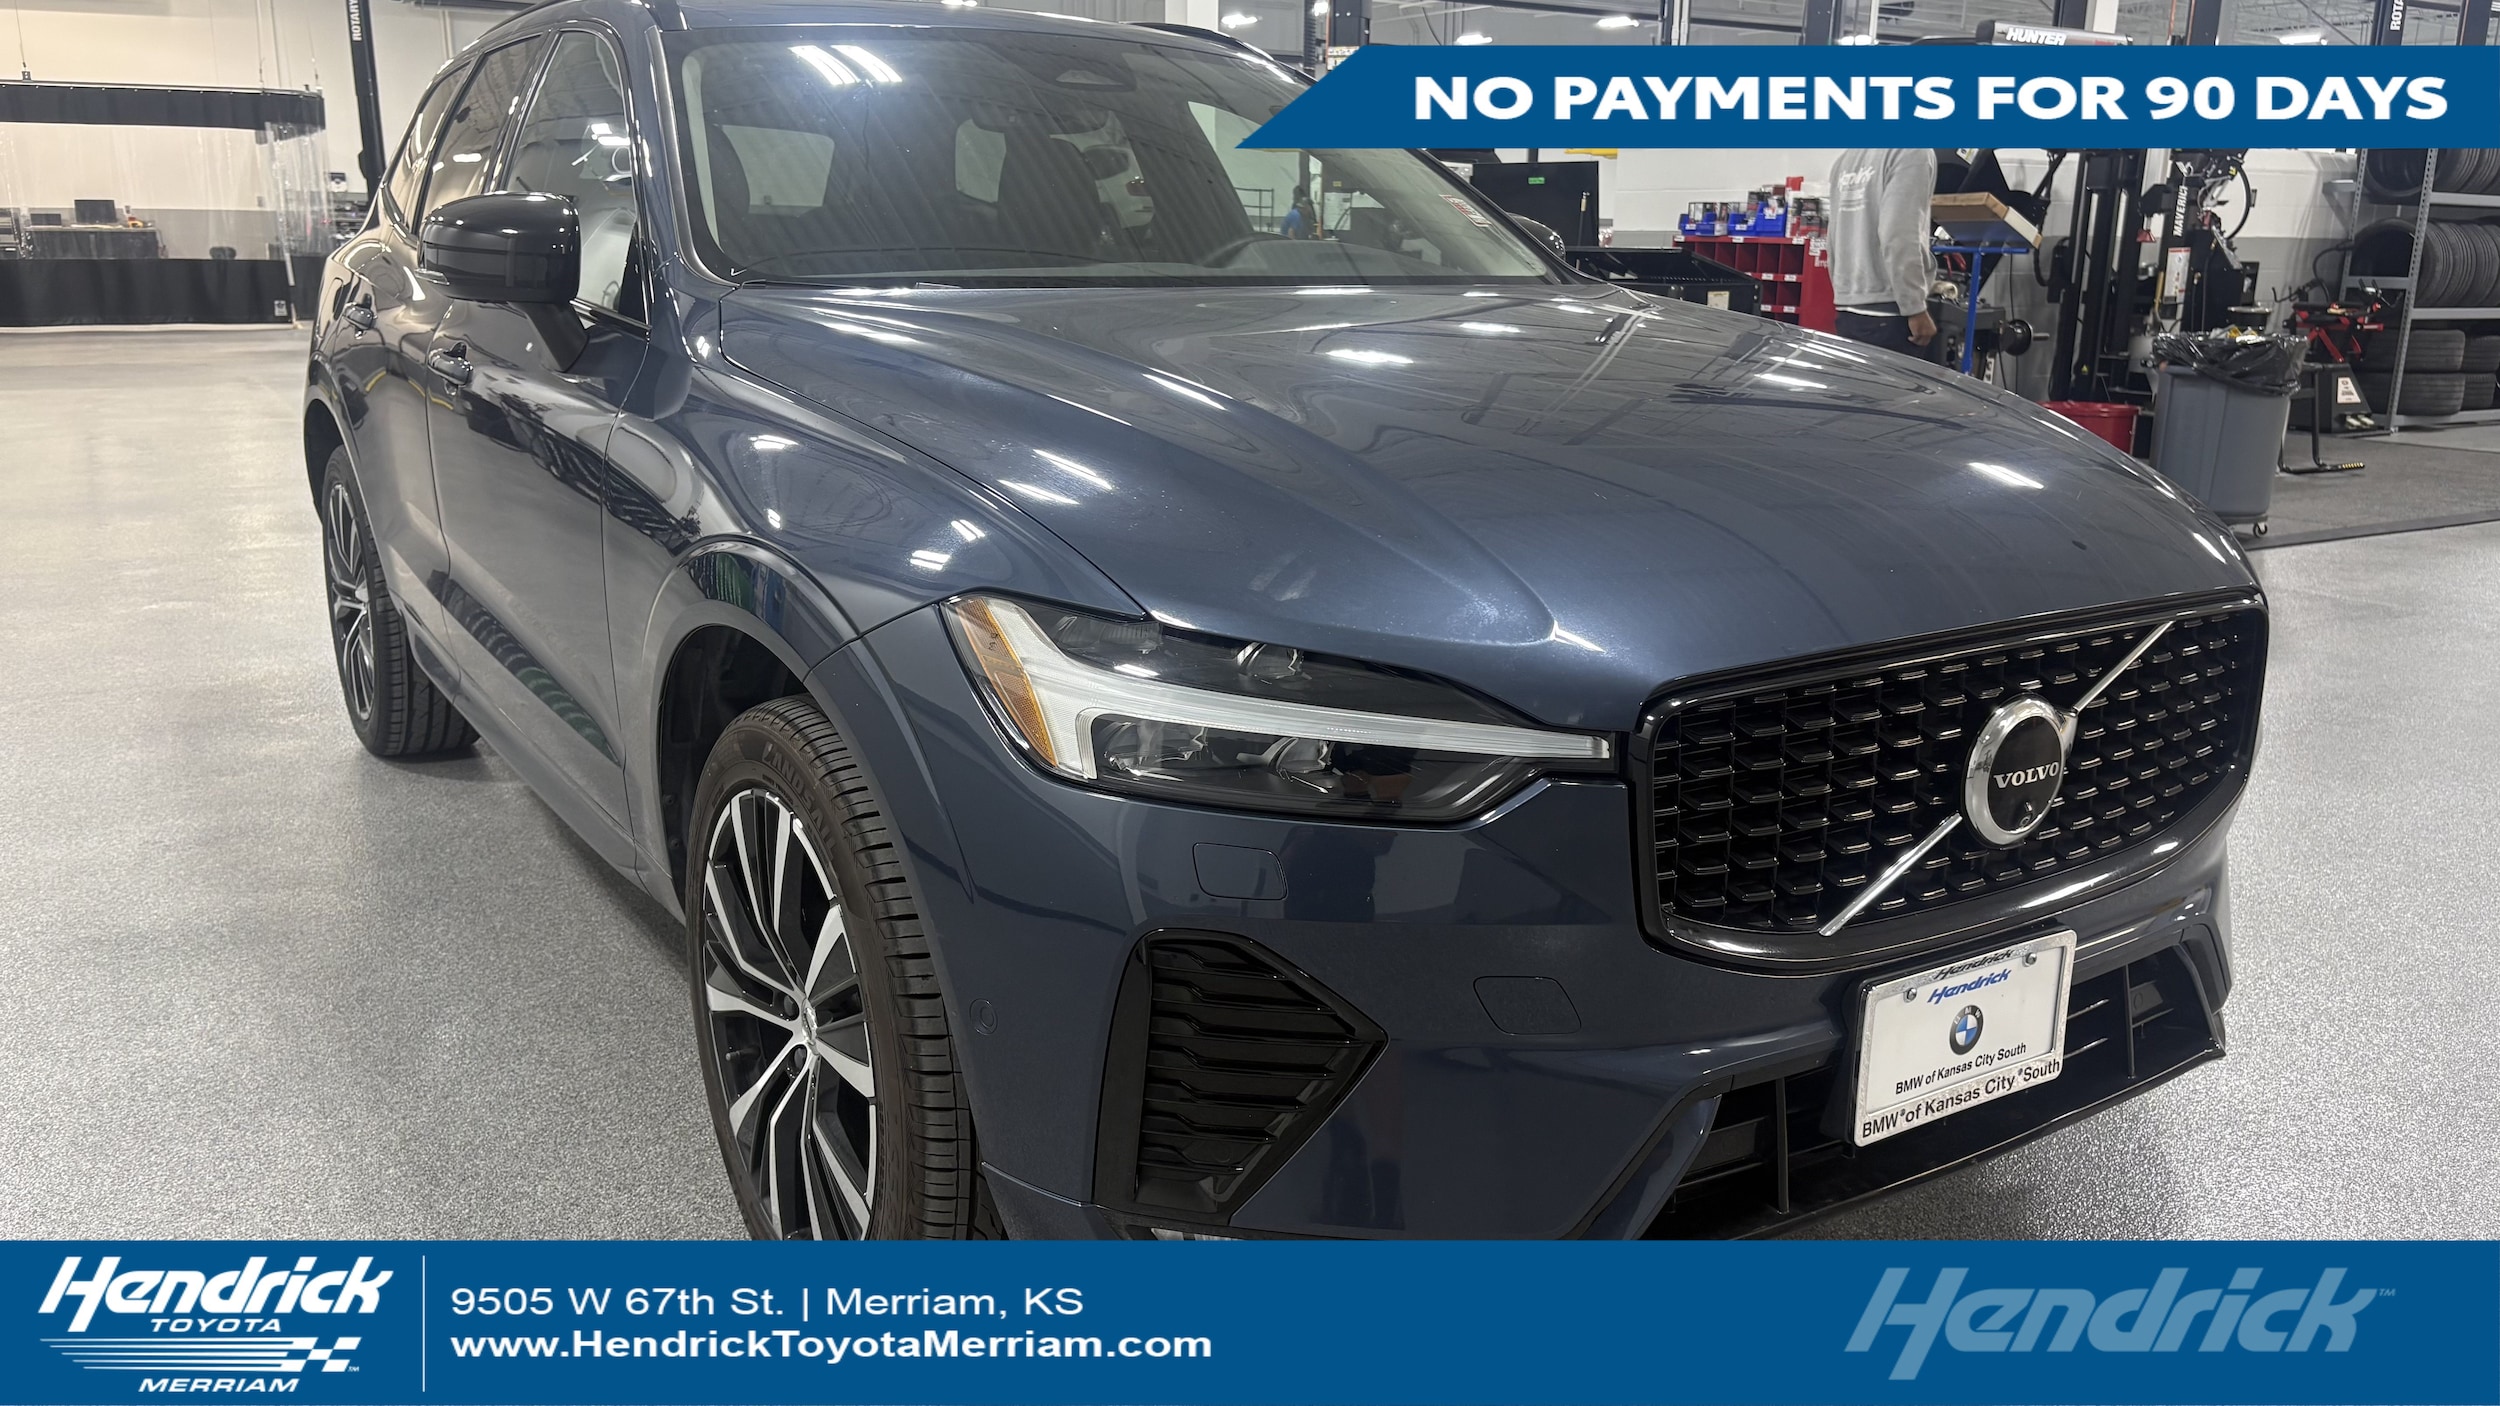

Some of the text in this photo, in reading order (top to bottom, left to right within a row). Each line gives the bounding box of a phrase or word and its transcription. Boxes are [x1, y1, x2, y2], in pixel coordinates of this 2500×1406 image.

[2005, 27, 2067, 46] HUNTER
[1993, 761, 2060, 789] VOLVO
[1933, 949, 2014, 980] Hendrick
[1927, 968, 2012, 1005] Hendrick
[1896, 1042, 2027, 1095] BMW of Kansas City South
[1862, 1058, 2060, 1139] BMW of Kansas City South
